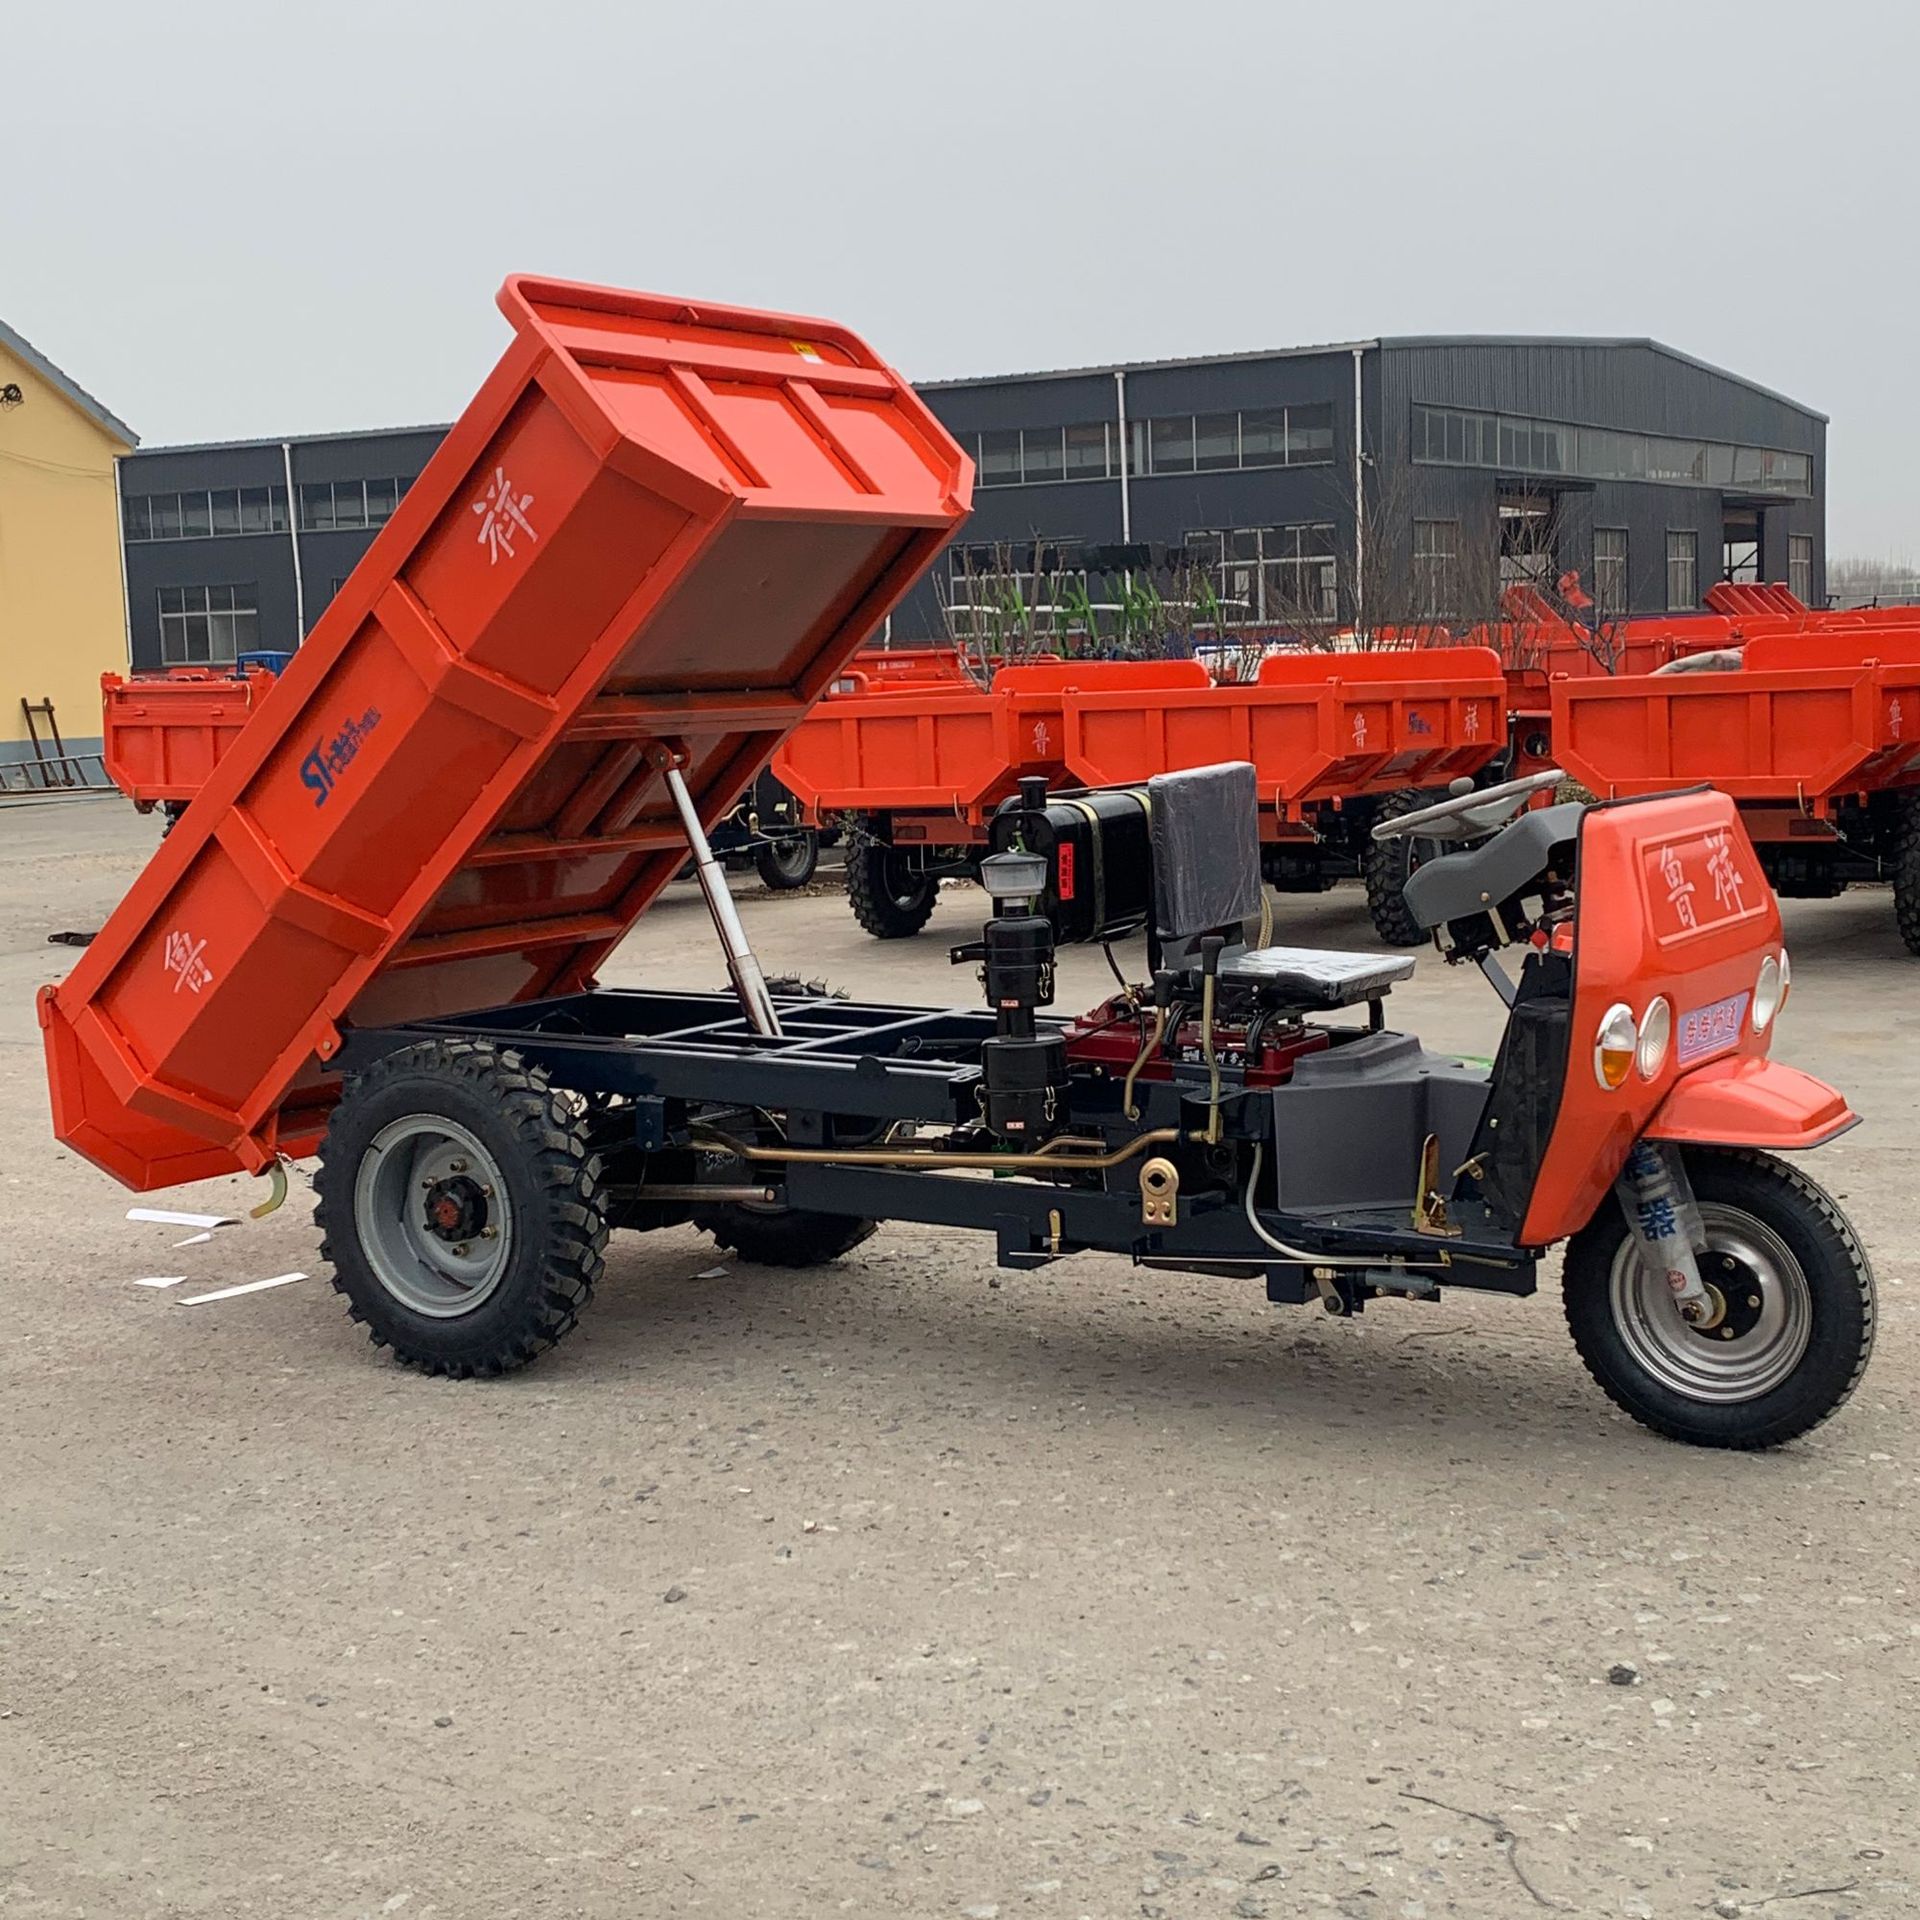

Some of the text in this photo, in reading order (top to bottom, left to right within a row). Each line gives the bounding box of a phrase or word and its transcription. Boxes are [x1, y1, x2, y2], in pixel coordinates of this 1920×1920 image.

[472, 466, 539, 566] 祥
[1032, 720, 1051, 757] 鲁
[1352, 711, 1367, 748] 鲁
[1660, 827, 1747, 928] 鲁祥
[164, 930, 214, 994] 鲁
